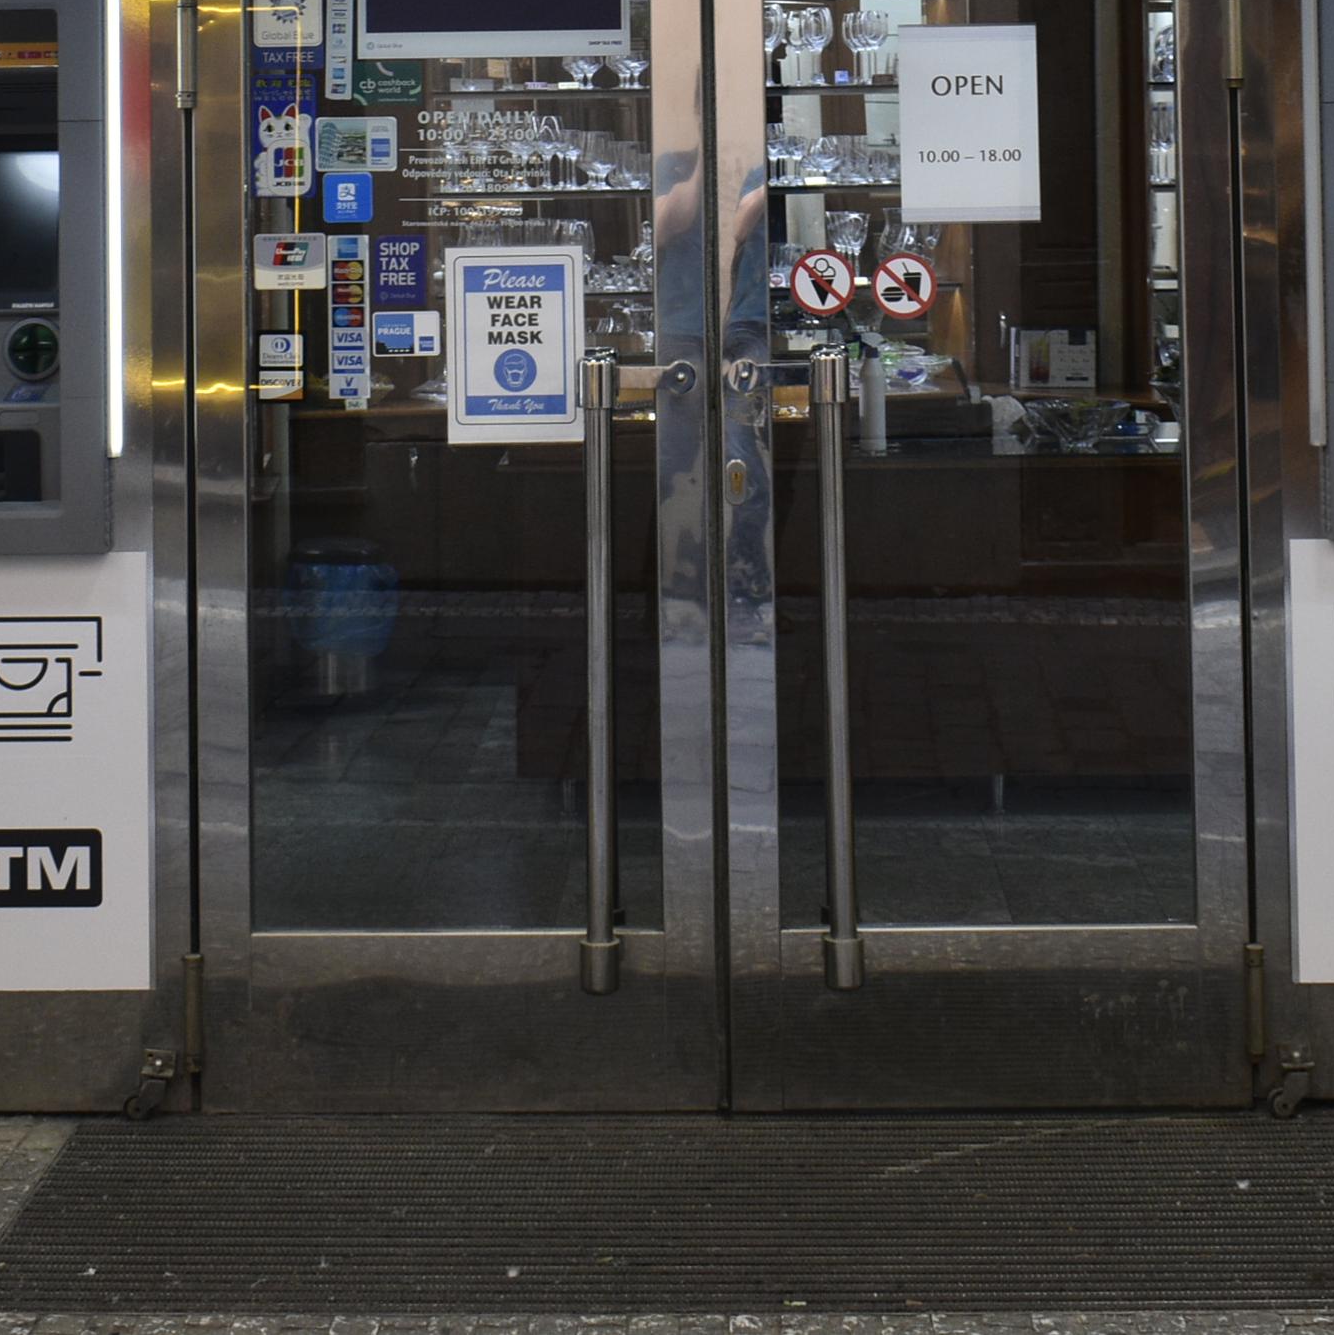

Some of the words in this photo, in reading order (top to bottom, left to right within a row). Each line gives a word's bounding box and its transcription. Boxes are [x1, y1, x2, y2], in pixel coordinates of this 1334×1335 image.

[262, 52, 284, 63] TAX
[286, 51, 315, 63] FREE
[931, 75, 1003, 96] OPEN
[417, 111, 471, 124] OPEN
[478, 110, 535, 124] DAILY
[417, 129, 463, 141] 10:00
[488, 128, 535, 141] 23:00
[919, 150, 960, 163] 10.00
[980, 149, 1021, 162] 18.00
[379, 242, 420, 256] SHOP
[379, 257, 410, 271] TAX
[379, 272, 417, 286] FREE
[483, 268, 546, 290] Please
[487, 296, 542, 309] WEAR
[491, 313, 539, 327] FACE
[336, 333, 363, 343] VISA
[377, 327, 412, 335] PRAGUE
[488, 331, 543, 345] MASK
[336, 356, 363, 366] VISA
[488, 398, 521, 411] Thank
[524, 399, 545, 413] You
